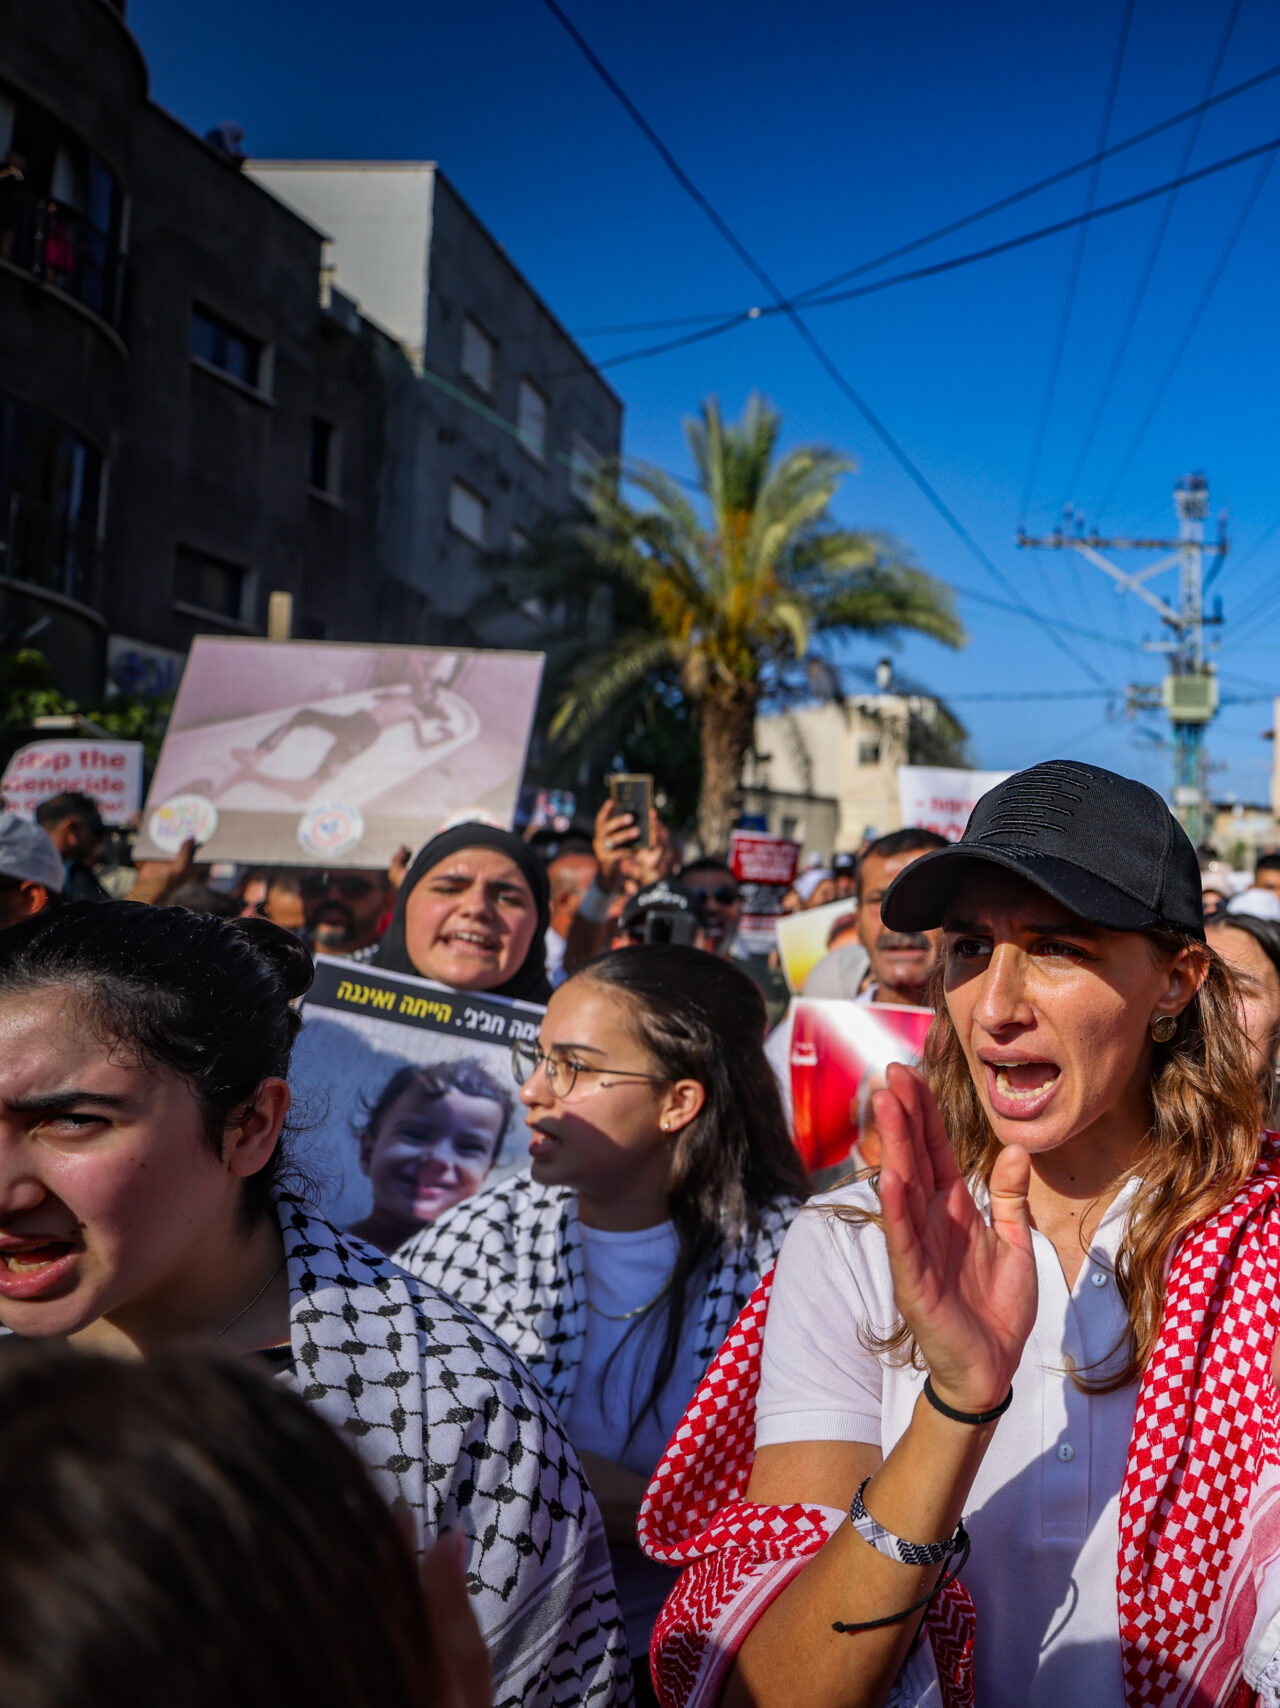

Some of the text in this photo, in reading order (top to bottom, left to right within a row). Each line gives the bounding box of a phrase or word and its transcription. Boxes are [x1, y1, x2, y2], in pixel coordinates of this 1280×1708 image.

[79, 748, 127, 770] the
[336, 980, 397, 1011] ואיננה
[399, 995, 453, 1024] הייתה
